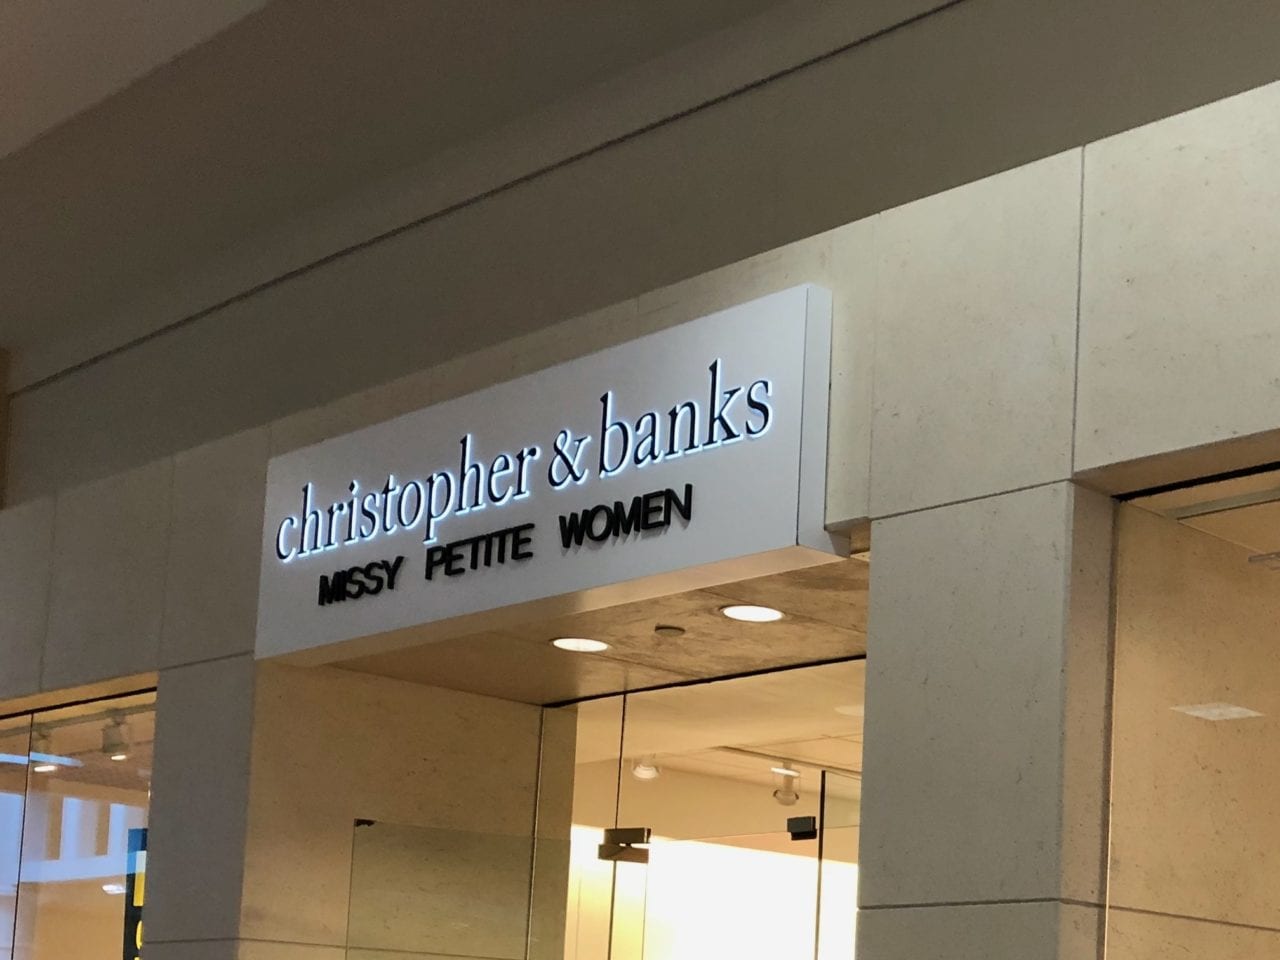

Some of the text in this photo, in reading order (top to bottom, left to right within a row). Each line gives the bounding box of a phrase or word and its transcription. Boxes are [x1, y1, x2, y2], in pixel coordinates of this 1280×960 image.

[276, 357, 774, 563] christopher & banks
[317, 482, 694, 605] MISSY PETITE WOMEN
